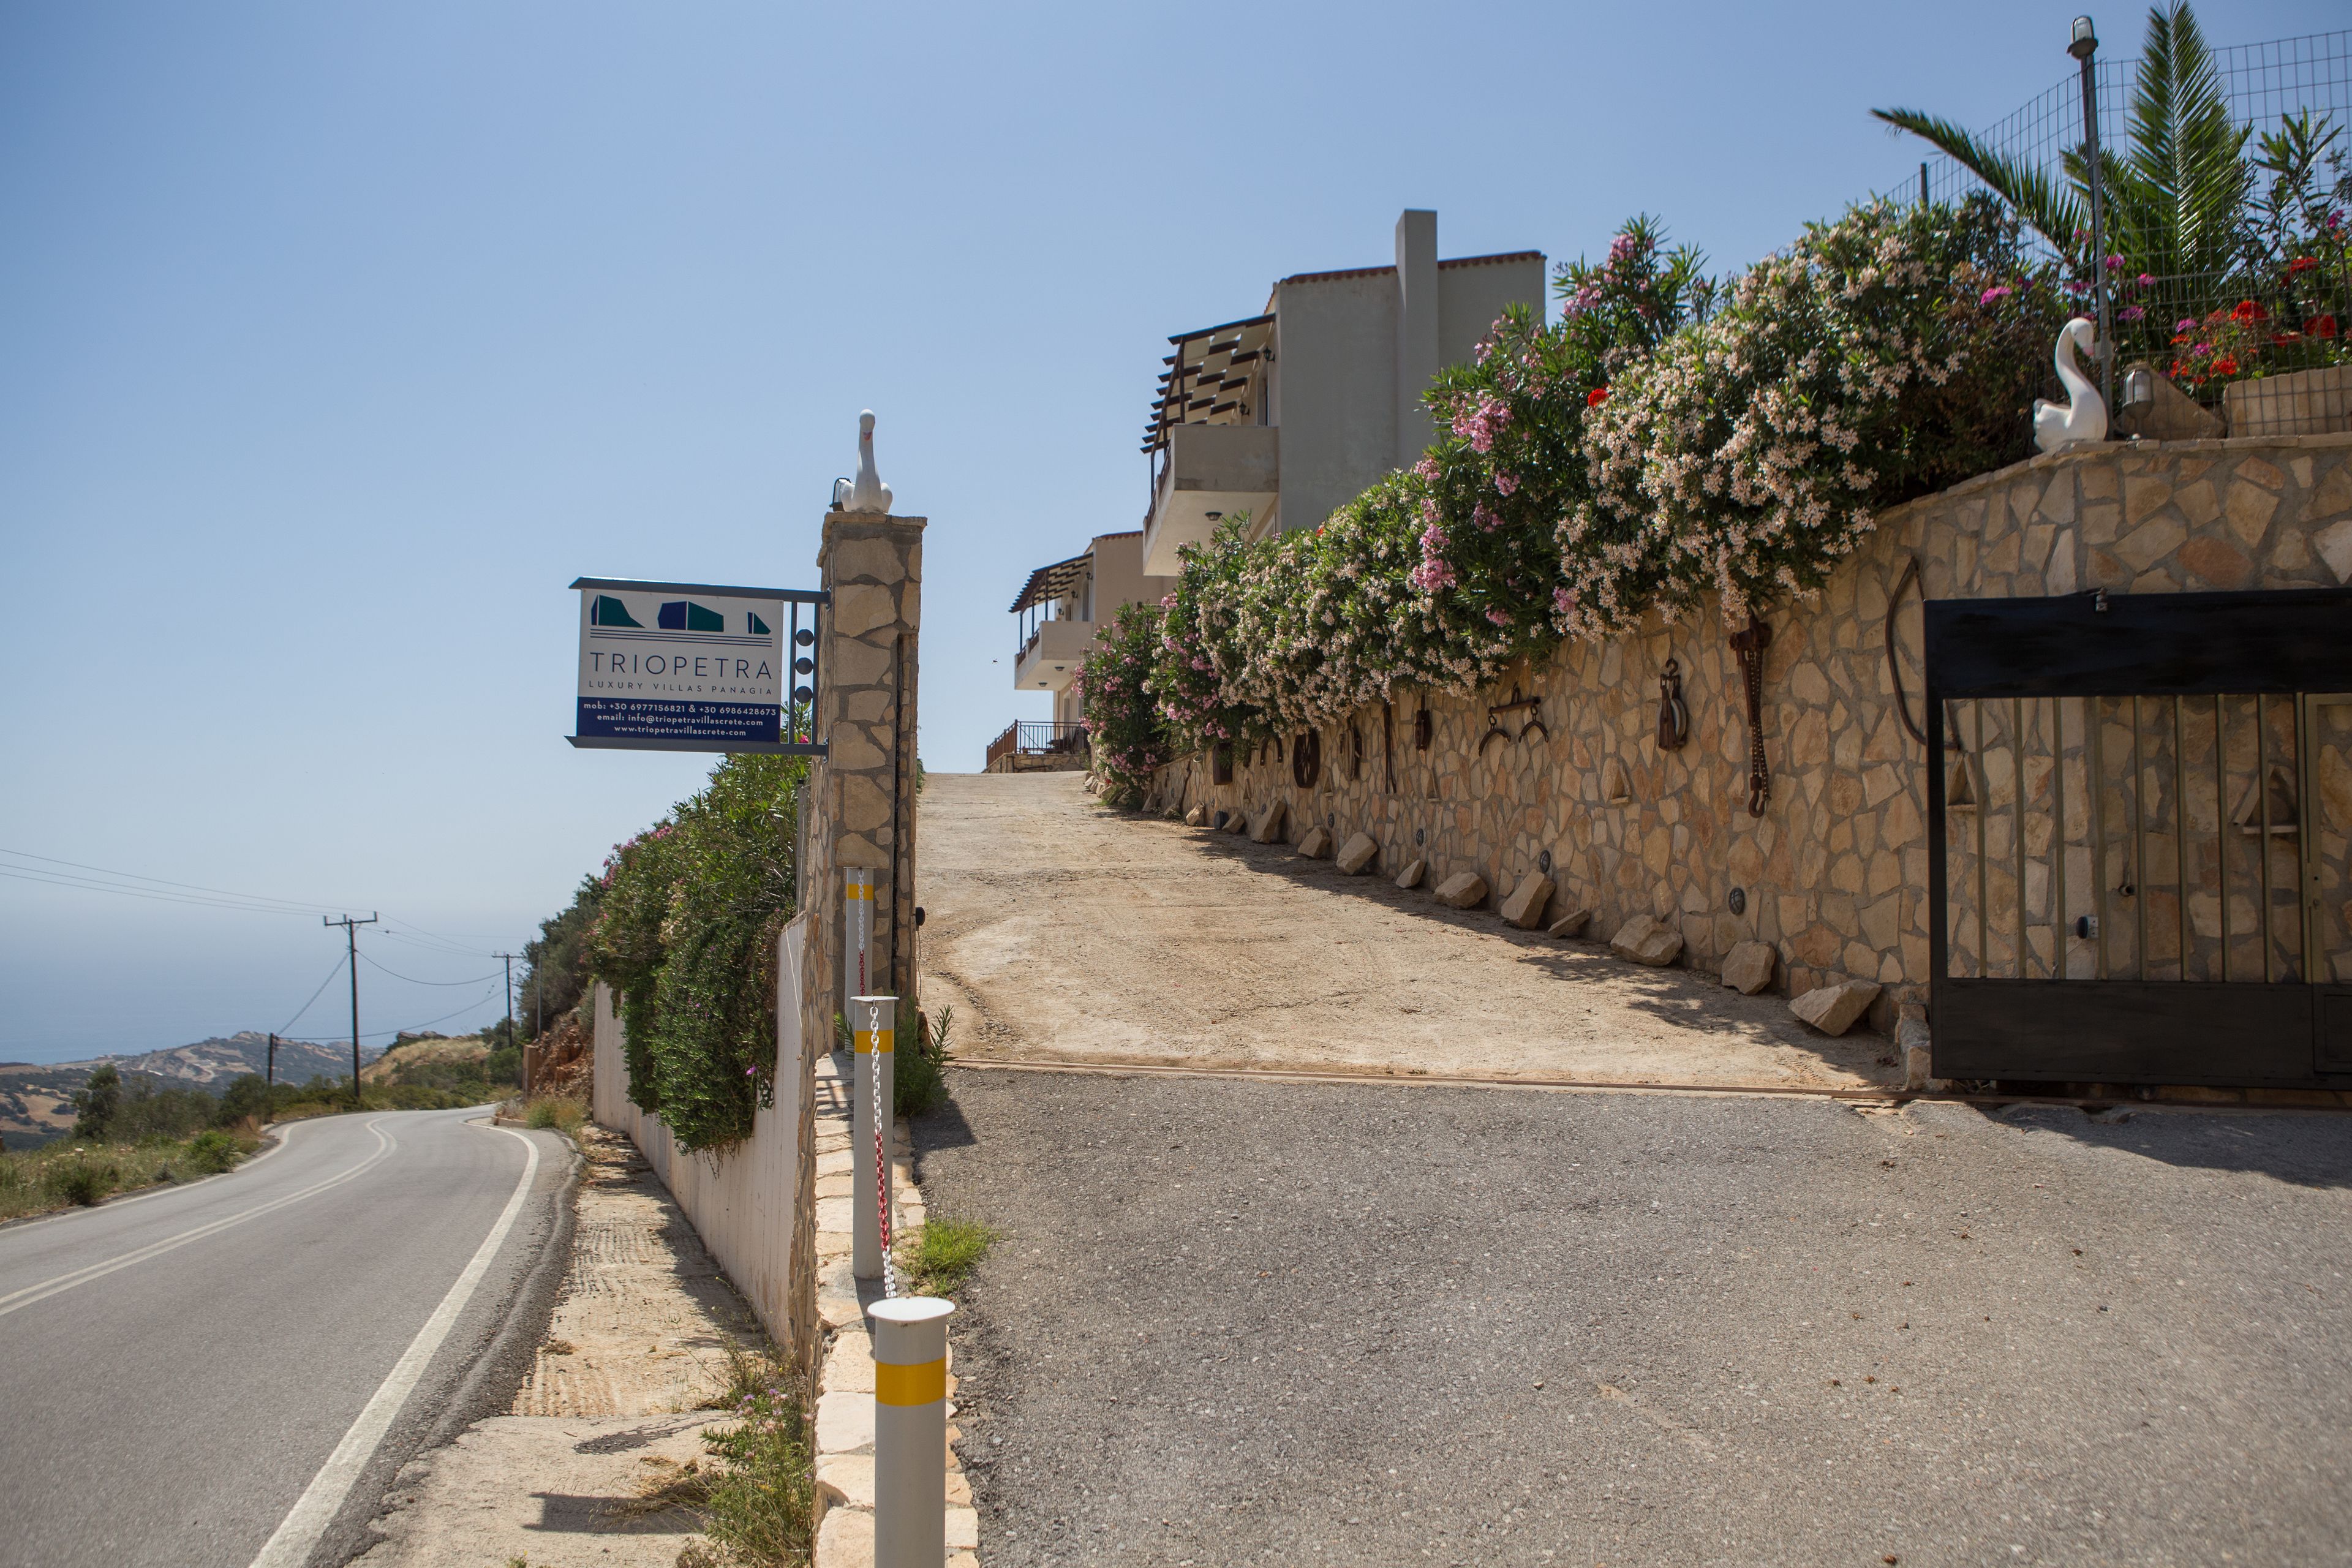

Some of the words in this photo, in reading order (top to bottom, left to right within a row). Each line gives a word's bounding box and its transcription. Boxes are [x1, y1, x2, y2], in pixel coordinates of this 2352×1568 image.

[589, 652, 772, 680] TRIOPETRA
[589, 680, 643, 690] LUXURY
[653, 683, 703, 692] VILLAS
[712, 685, 772, 695] PANAGIA
[584, 701, 606, 709] mob:
[630, 703, 685, 712] 6977156821
[688, 704, 696, 713] &
[720, 707, 777, 716] 6986428673
[597, 712, 625, 721] email:
[628, 713, 763, 726] info@triopetravillascrete.com
[614, 725, 746, 736] www.triopetravillascrete.com
